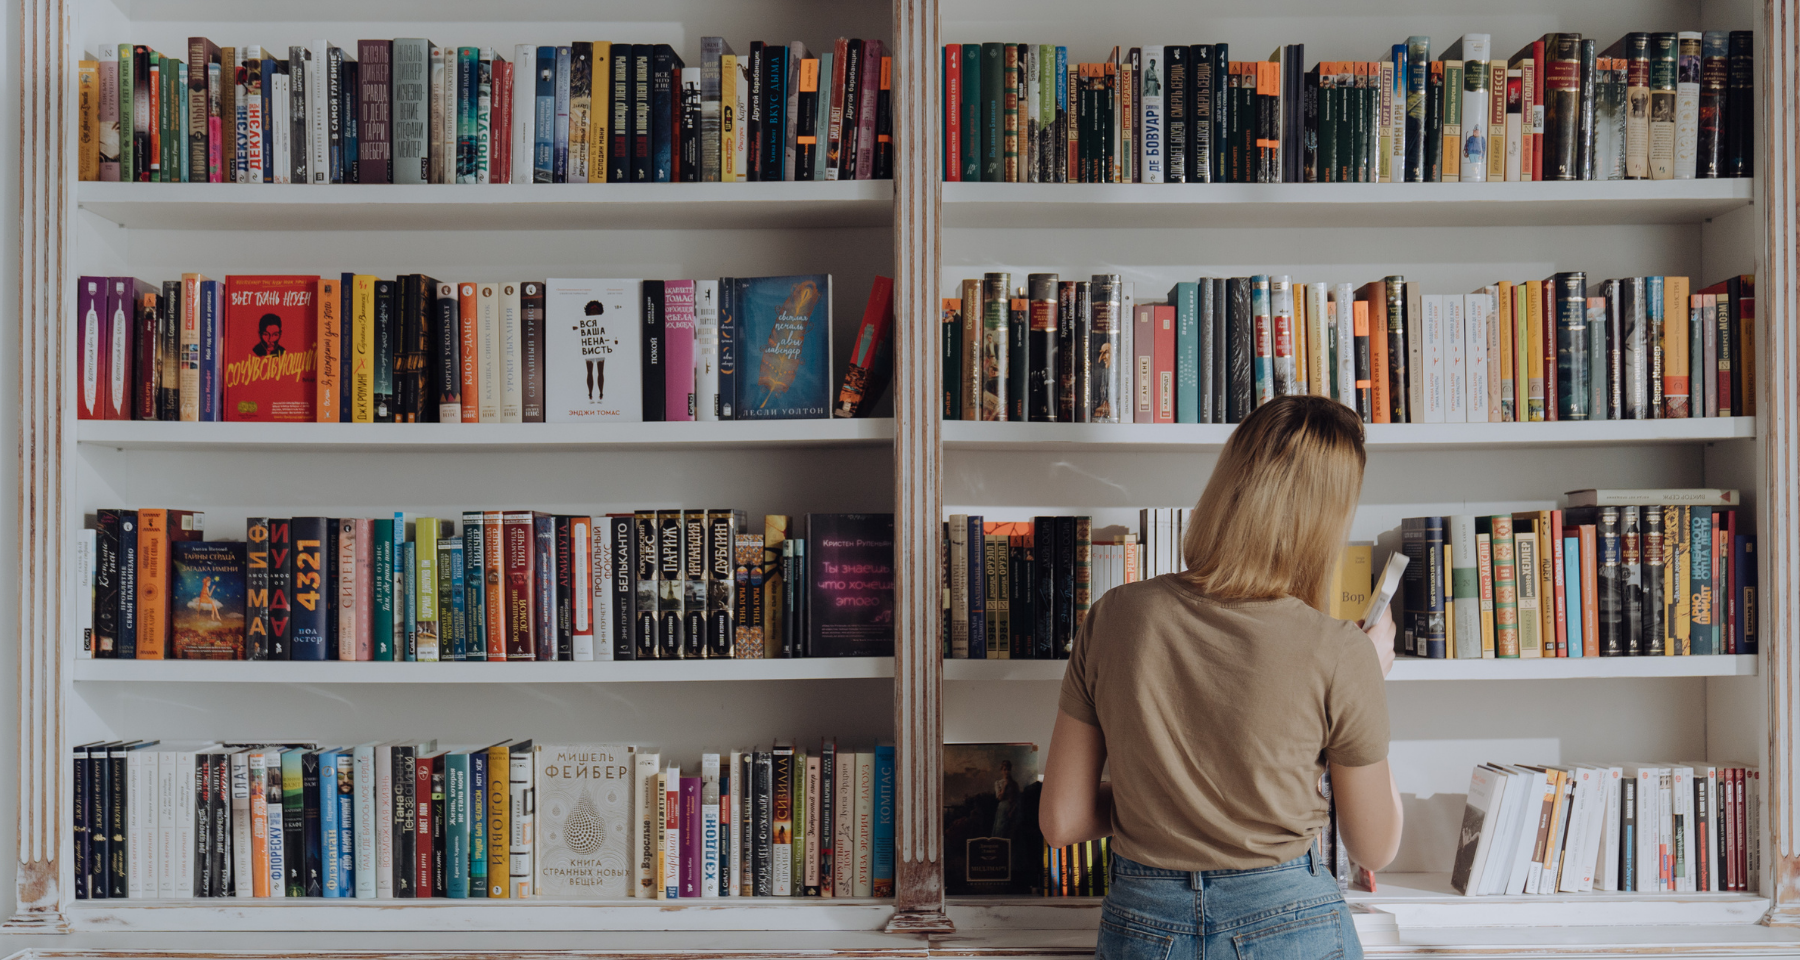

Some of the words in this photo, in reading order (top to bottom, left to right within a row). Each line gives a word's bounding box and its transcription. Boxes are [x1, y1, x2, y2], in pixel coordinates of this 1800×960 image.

[363, 46, 389, 63] ЖОЭЛЬ
[397, 44, 423, 62] ЖОЭЛЬ
[330, 55, 339, 96] ГЛУБИНЕ
[362, 63, 389, 84] ДИККЕР
[752, 51, 760, 94] барабанщик
[771, 57, 779, 91] ДЫМА
[848, 49, 857, 92] барабанщик
[1171, 64, 1185, 89] СЕРДЦА
[1197, 62, 1211, 87] СЕРДЦА
[1495, 70, 1503, 95] ГЕССЕ
[363, 84, 387, 105] ПРАВДА
[752, 95, 760, 121] Другой
[769, 94, 780, 123] ВКУС
[846, 93, 854, 119] Другой
[1171, 90, 1183, 118] СМЕРТЬ
[1197, 89, 1210, 116] СМЕРТЬ
[330, 98, 339, 131] САМОЙ
[363, 103, 368, 121] О
[370, 103, 388, 124] ДЕЛЕ
[1394, 104, 1403, 125] ГАРИ
[248, 109, 262, 170] ДЕКУЭН
[365, 123, 385, 141] ГАРРИ
[397, 122, 423, 141] СТЕФАНИ
[477, 112, 488, 171] ДЮБУА
[1146, 110, 1159, 156] БОВУАР
[1171, 121, 1183, 143] БОУЭН
[1197, 120, 1210, 142] БОУЭН
[1394, 127, 1404, 156] РОМЕН
[360, 142, 390, 160] КВЕБЕРТА
[397, 138, 422, 158] МЕЙЛЕР
[1171, 144, 1183, 179] ЭЛИЗАБЕТ
[1197, 144, 1210, 178] ЭЛИЗАБЕТ
[1149, 160, 1161, 172] ДЕ
[231, 291, 253, 305] ВЬЕТ
[254, 291, 280, 306] ТХАНЬ
[283, 291, 312, 306] НГУЕН
[966, 288, 974, 329] Освобождение
[580, 319, 597, 328] ВСЯ
[1718, 304, 1727, 330] МОЭМ
[506, 308, 514, 357] ДЫХАНИЯ
[580, 327, 606, 337] ВАША
[582, 346, 613, 355] ВИСТЬ
[1652, 346, 1662, 378] Миллер
[1374, 386, 1382, 417] джозеф
[1653, 380, 1661, 405] Генри
[743, 408, 777, 417] ЛЕСЛИ
[782, 407, 824, 415] УОЛТОН
[1701, 517, 1711, 546] ДЕТИ
[473, 529, 482, 566] ПИЛЧЕР
[492, 528, 500, 566] ПИЛЧЕР
[517, 528, 526, 566] ПИЛЧЕР
[559, 525, 568, 587] АРМИНУТА
[603, 543, 612, 579] ФОКУС
[618, 523, 629, 592] БЕЛЬКАНТО
[986, 545, 994, 575] ОРУЭЛЛ
[1127, 544, 1135, 572] РЕМАРК
[1480, 544, 1490, 577] ХАКСЛИ
[1521, 541, 1531, 575] ХЕЛЛЕР
[1690, 516, 1701, 580] НИЧЕЙНОГО
[297, 539, 321, 611] 4321
[343, 542, 353, 609] СИРЕНА
[593, 526, 603, 597] ПРОЩАЛЬНЫЙ
[822, 561, 838, 573] Ты
[842, 564, 890, 573] знаешь
[1543, 558, 1551, 582] ИЗГОЙ
[1701, 550, 1711, 580] ОТЦА
[817, 581, 846, 590] что
[848, 580, 894, 590] хочешь
[1342, 591, 1365, 604] Вор
[1484, 578, 1492, 598] ОЛДОС
[1525, 575, 1533, 597] ДЖОЗЕФ
[519, 599, 528, 633] ДОМОЙ
[836, 597, 880, 607] этого
[1692, 593, 1701, 623] АРНО
[1701, 584, 1711, 624] ШМИДТ
[988, 620, 996, 646] 1984
[361, 755, 370, 783] СЕРДЦЕ
[545, 763, 627, 779] ФЕЙБЕР
[557, 753, 614, 762] МИШЕЛЬ
[403, 756, 415, 795] спиной
[778, 758, 788, 819] СИВИЛЛА
[404, 796, 413, 808] за
[881, 767, 892, 824] КОМПАС
[362, 804, 370, 835] БИЛОСЬ
[403, 809, 414, 834] Тень
[491, 780, 505, 865] СОЛОВЕЙ
[363, 837, 371, 850] ГДЕ
[382, 809, 390, 868] ВОЗМОЖНАЯ
[641, 820, 652, 869] Взрослые
[705, 819, 717, 881] ХЭДДОН
[270, 826, 282, 880] ФЛОРЕСКУ
[326, 829, 337, 890] Флэнаган
[363, 852, 371, 871] ТАМ,
[570, 859, 602, 867] КНИГА
[843, 850, 851, 870] ДОМ
[569, 877, 603, 886] ВЕЩЕЙ
[596, 869, 630, 877] НОВЫХ
[1530, 866, 1539, 890] LAROUSSE
[1549, 866, 1558, 890] LAROUSSE
